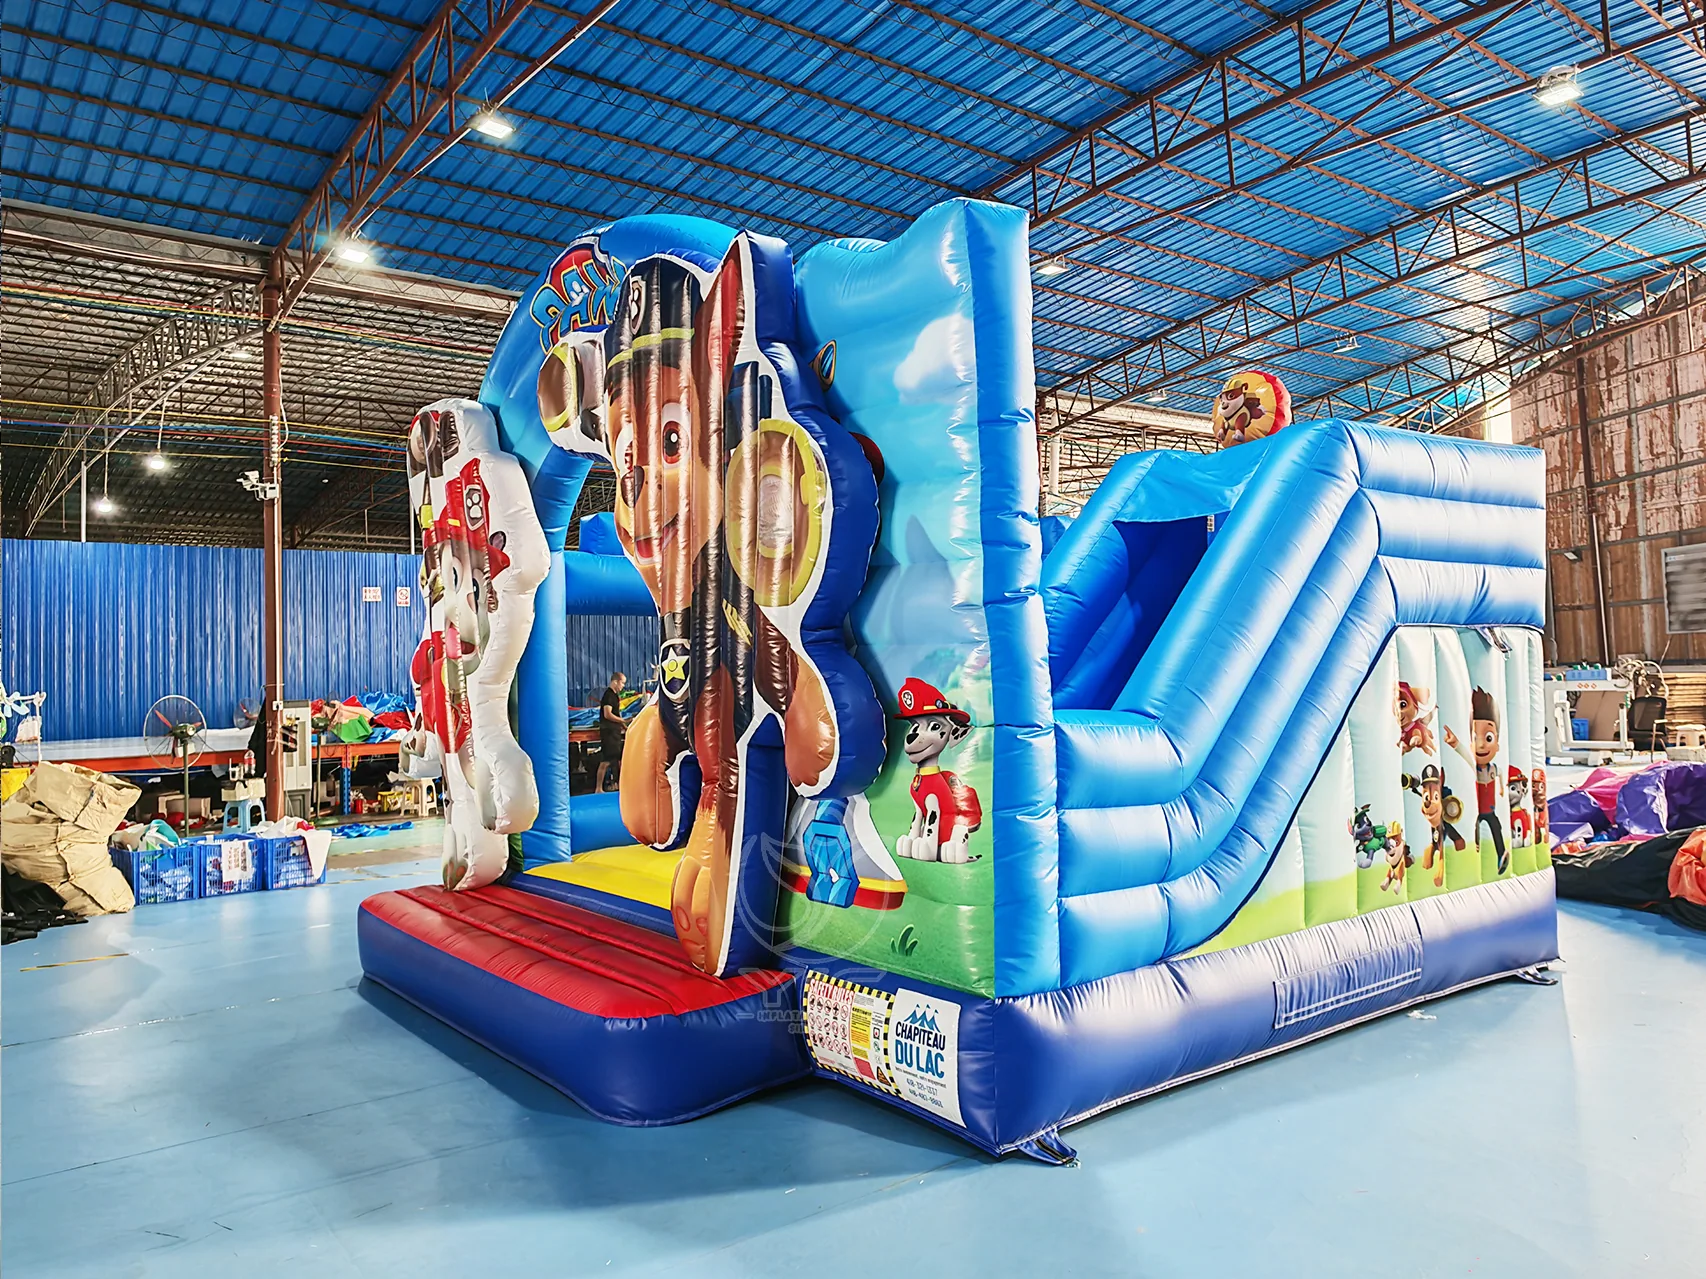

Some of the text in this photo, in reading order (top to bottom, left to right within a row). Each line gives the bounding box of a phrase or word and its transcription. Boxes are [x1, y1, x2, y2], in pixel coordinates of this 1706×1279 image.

[809, 979, 833, 999] SAFETY
[832, 986, 855, 1005] RULES
[895, 1021, 946, 1051] CHAPITEAU
[895, 1039, 914, 1068] DU
[915, 1047, 945, 1079] LAC
